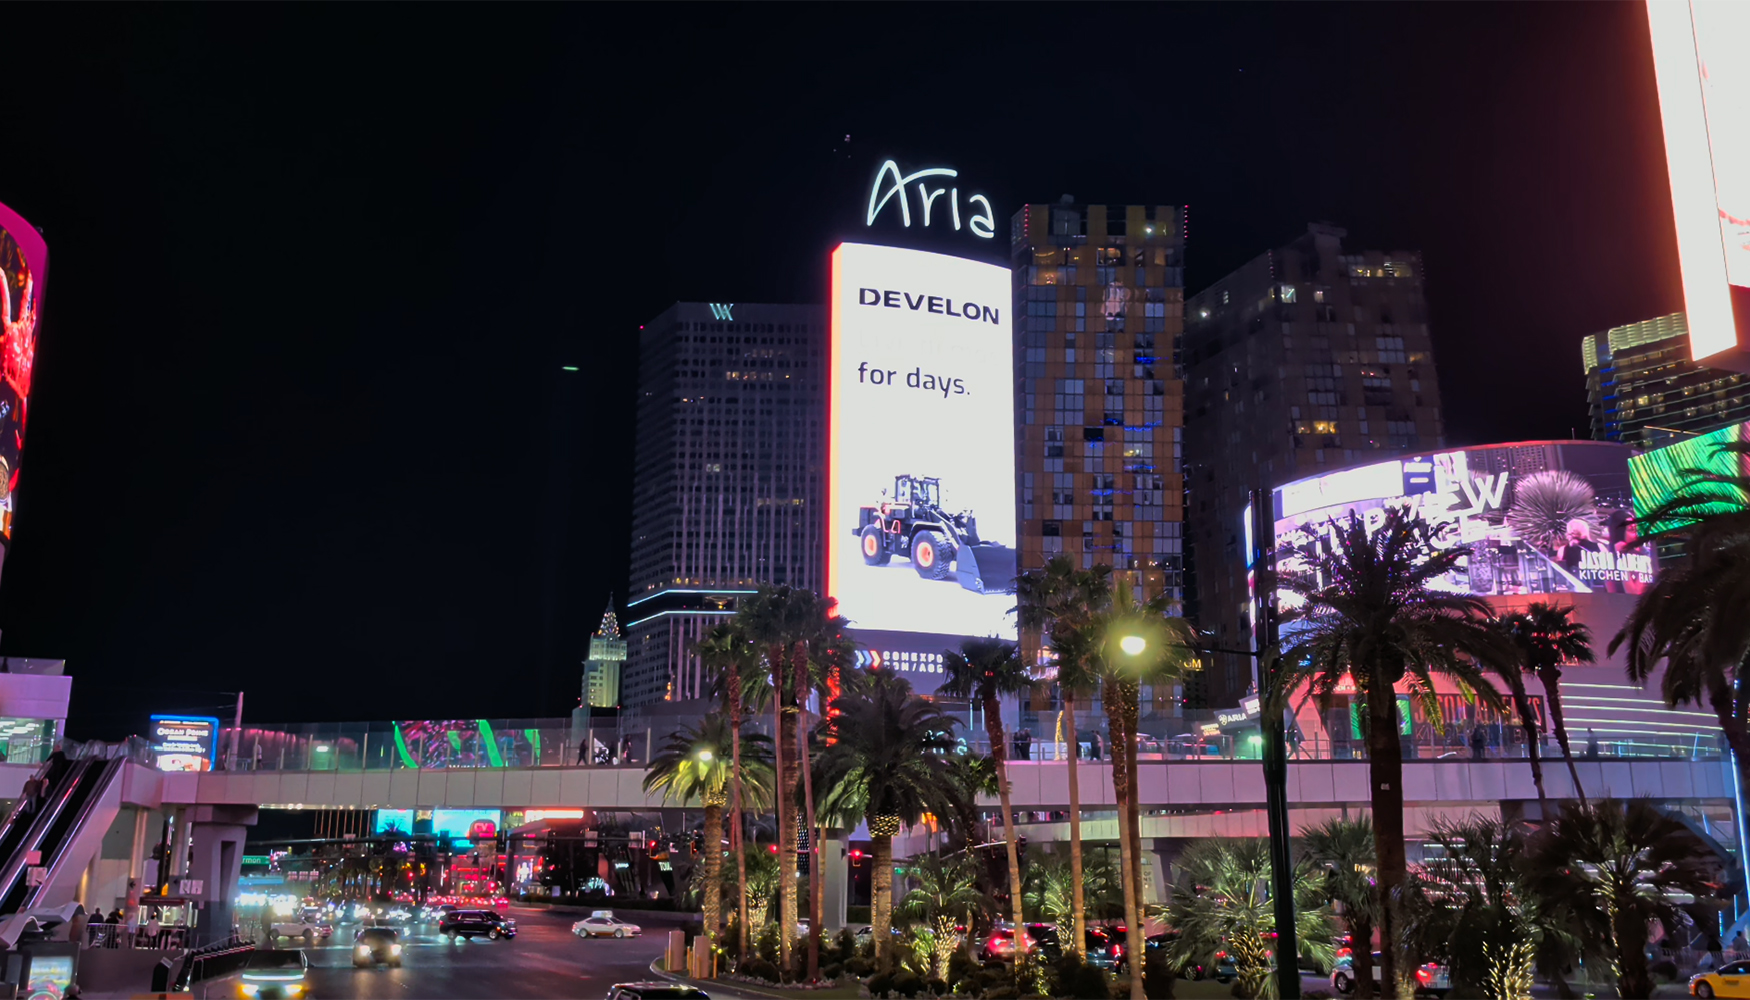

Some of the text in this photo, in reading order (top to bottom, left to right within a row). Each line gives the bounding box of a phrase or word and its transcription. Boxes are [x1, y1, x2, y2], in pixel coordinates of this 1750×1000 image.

[867, 159, 995, 238] Aria
[858, 287, 1000, 325] DEVELON
[858, 361, 971, 398] for days.
[1579, 569, 1629, 581] KITCHEN
[882, 650, 943, 663] CONEXPO
[1228, 712, 1247, 722] ARIA
[474, 822, 495, 833] CVS
[242, 856, 262, 864] rmon
